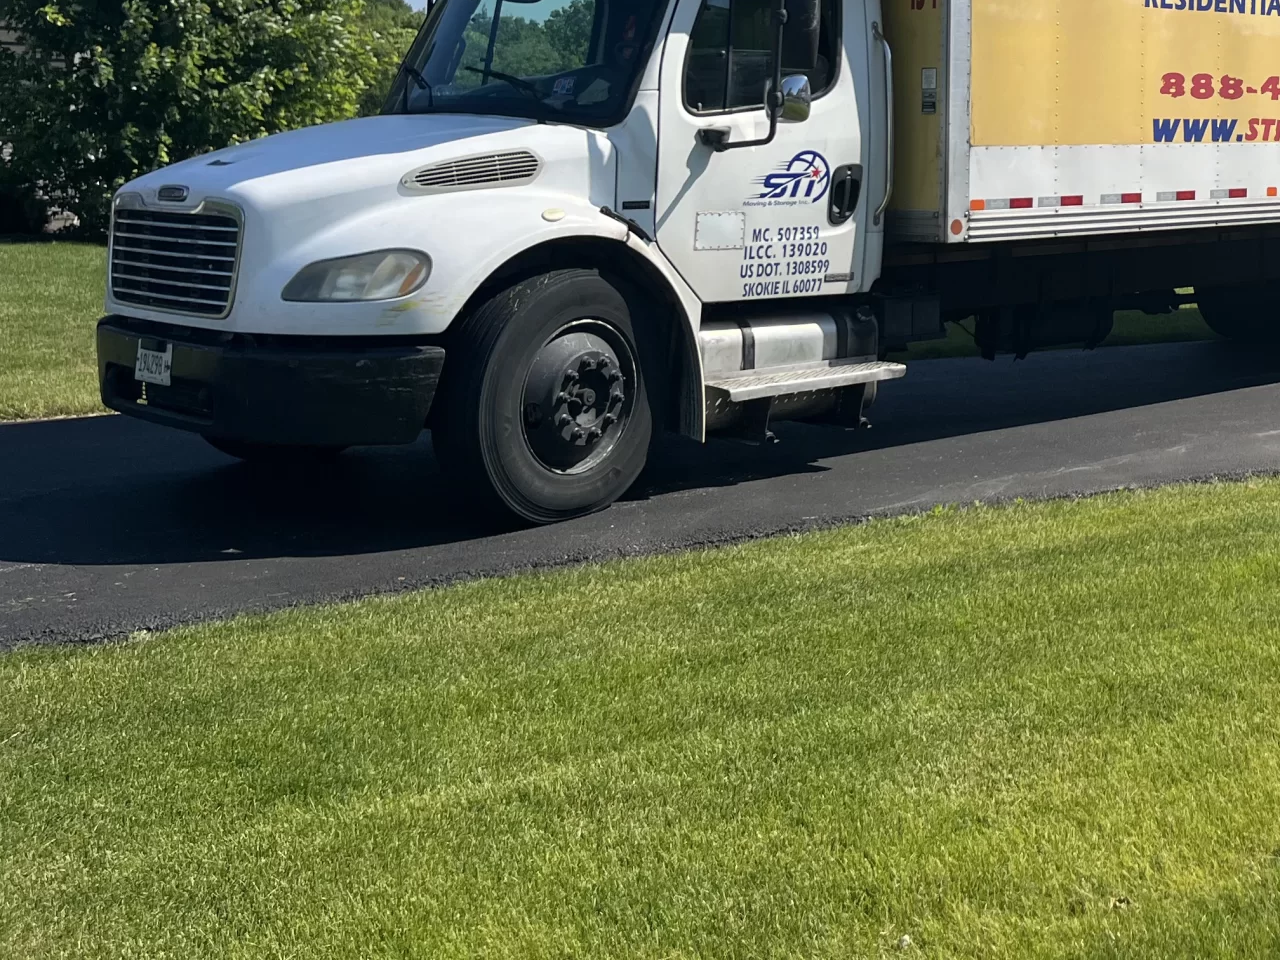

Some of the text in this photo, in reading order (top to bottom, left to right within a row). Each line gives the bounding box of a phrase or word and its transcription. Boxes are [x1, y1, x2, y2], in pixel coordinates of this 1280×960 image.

[742, 200, 767, 208] Moving
[752, 225, 820, 243] MC. 507359
[743, 242, 828, 260] ILCC. 139020
[740, 259, 830, 279] US DOT. 1308599
[742, 280, 781, 298] SKOKIE
[782, 279, 791, 294] IL
[792, 277, 823, 294] 60077
